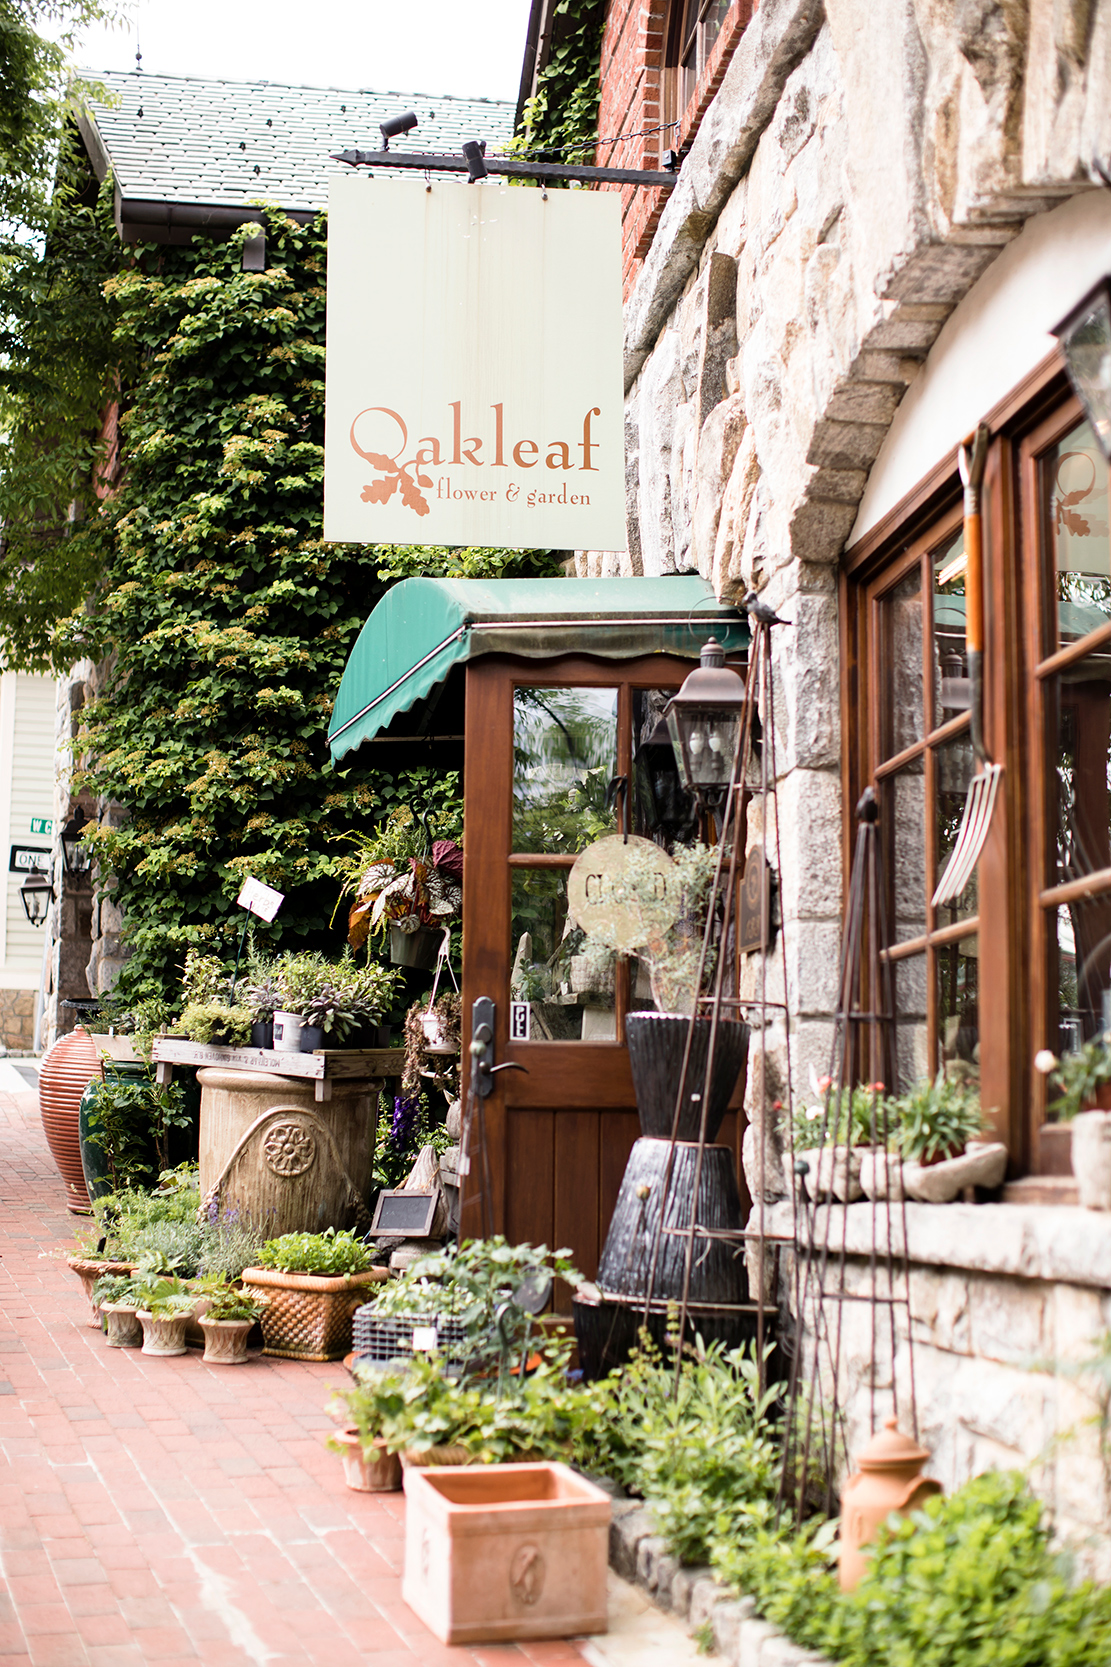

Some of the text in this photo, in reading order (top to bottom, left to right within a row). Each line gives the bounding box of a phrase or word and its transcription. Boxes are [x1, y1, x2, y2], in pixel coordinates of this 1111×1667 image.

[350, 401, 601, 471] Oakleaf
[436, 477, 592, 508] flower & garden
[19, 853, 44, 867] ONE
